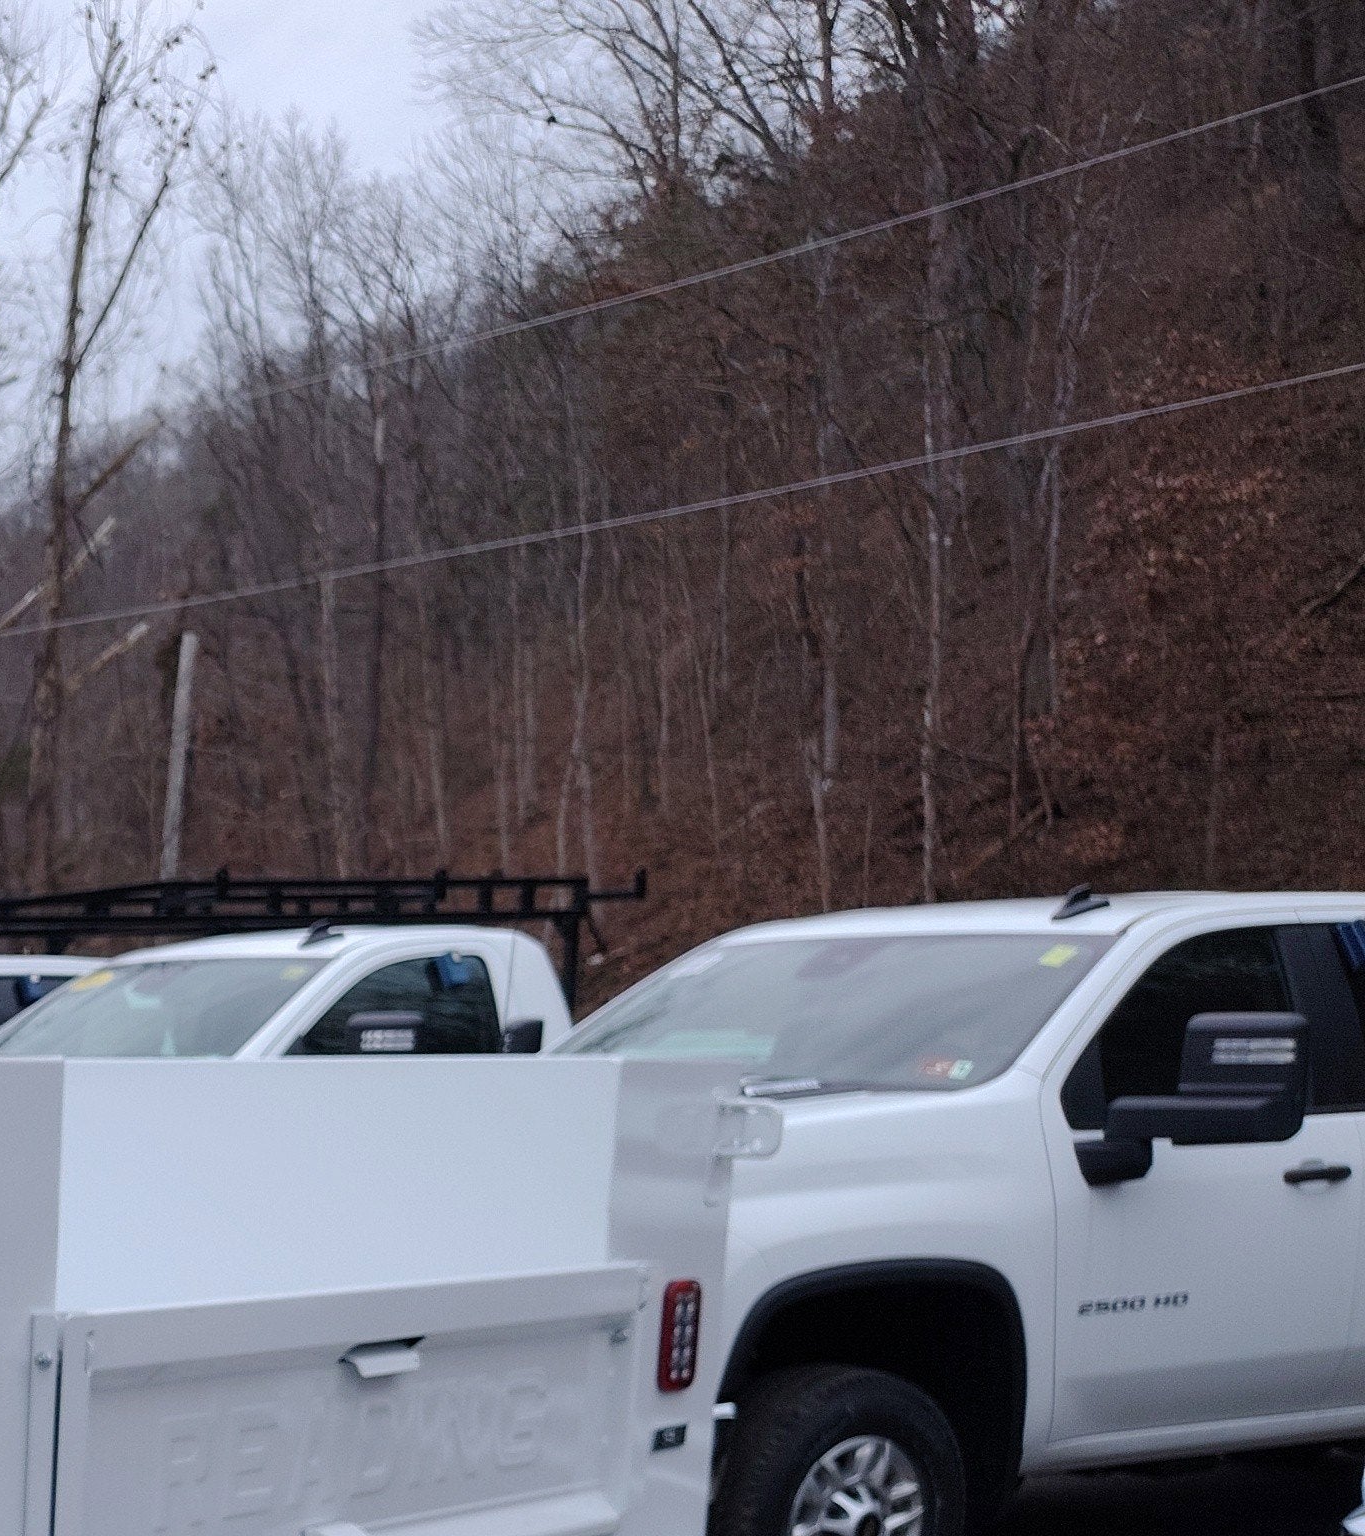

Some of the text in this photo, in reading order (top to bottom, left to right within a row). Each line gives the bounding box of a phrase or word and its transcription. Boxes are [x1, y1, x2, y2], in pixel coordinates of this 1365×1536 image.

[1077, 1291, 1189, 1316] 2500 HD
[152, 1372, 547, 1533] READING
